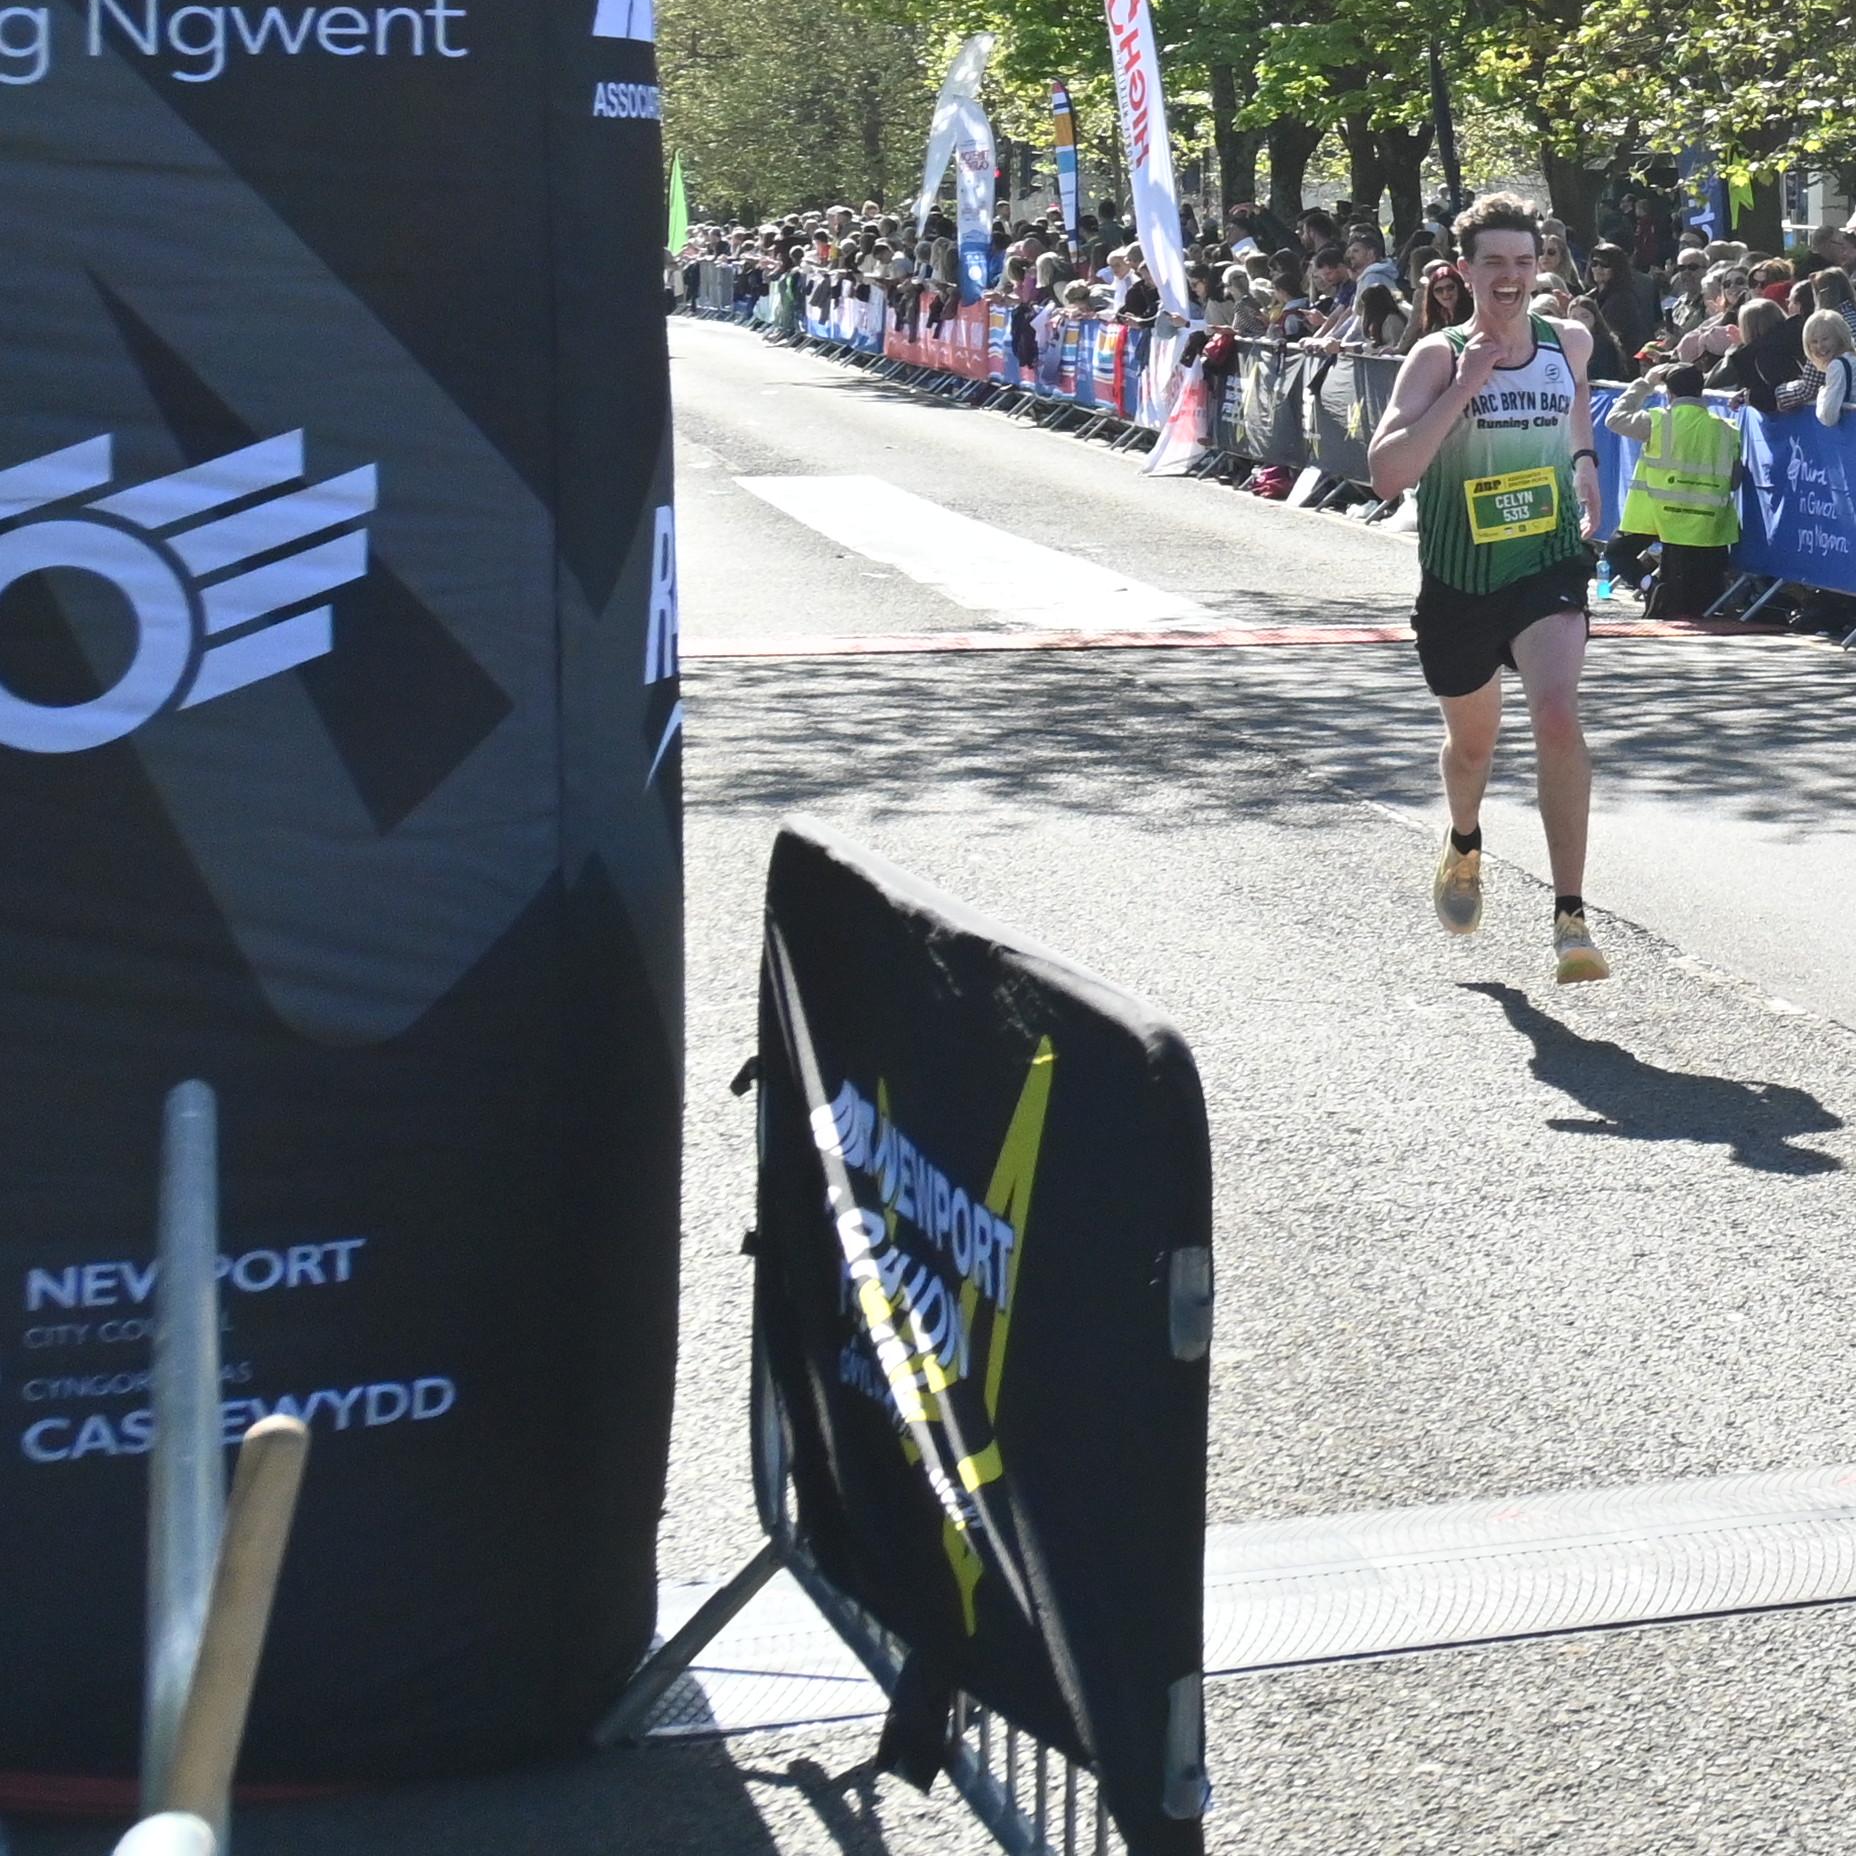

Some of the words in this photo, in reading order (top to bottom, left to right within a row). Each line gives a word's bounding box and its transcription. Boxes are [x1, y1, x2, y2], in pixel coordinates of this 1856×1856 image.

[1501, 391, 1536, 411] BRYN
[1477, 417, 1529, 430] Running
[1533, 416, 1558, 428] Club
[1495, 491, 1533, 509] CELYN
[1503, 506, 1529, 522] 5313
[873, 1115, 1015, 1312] NEWPORT
[21, 1376, 457, 1464] CASEWYDD
